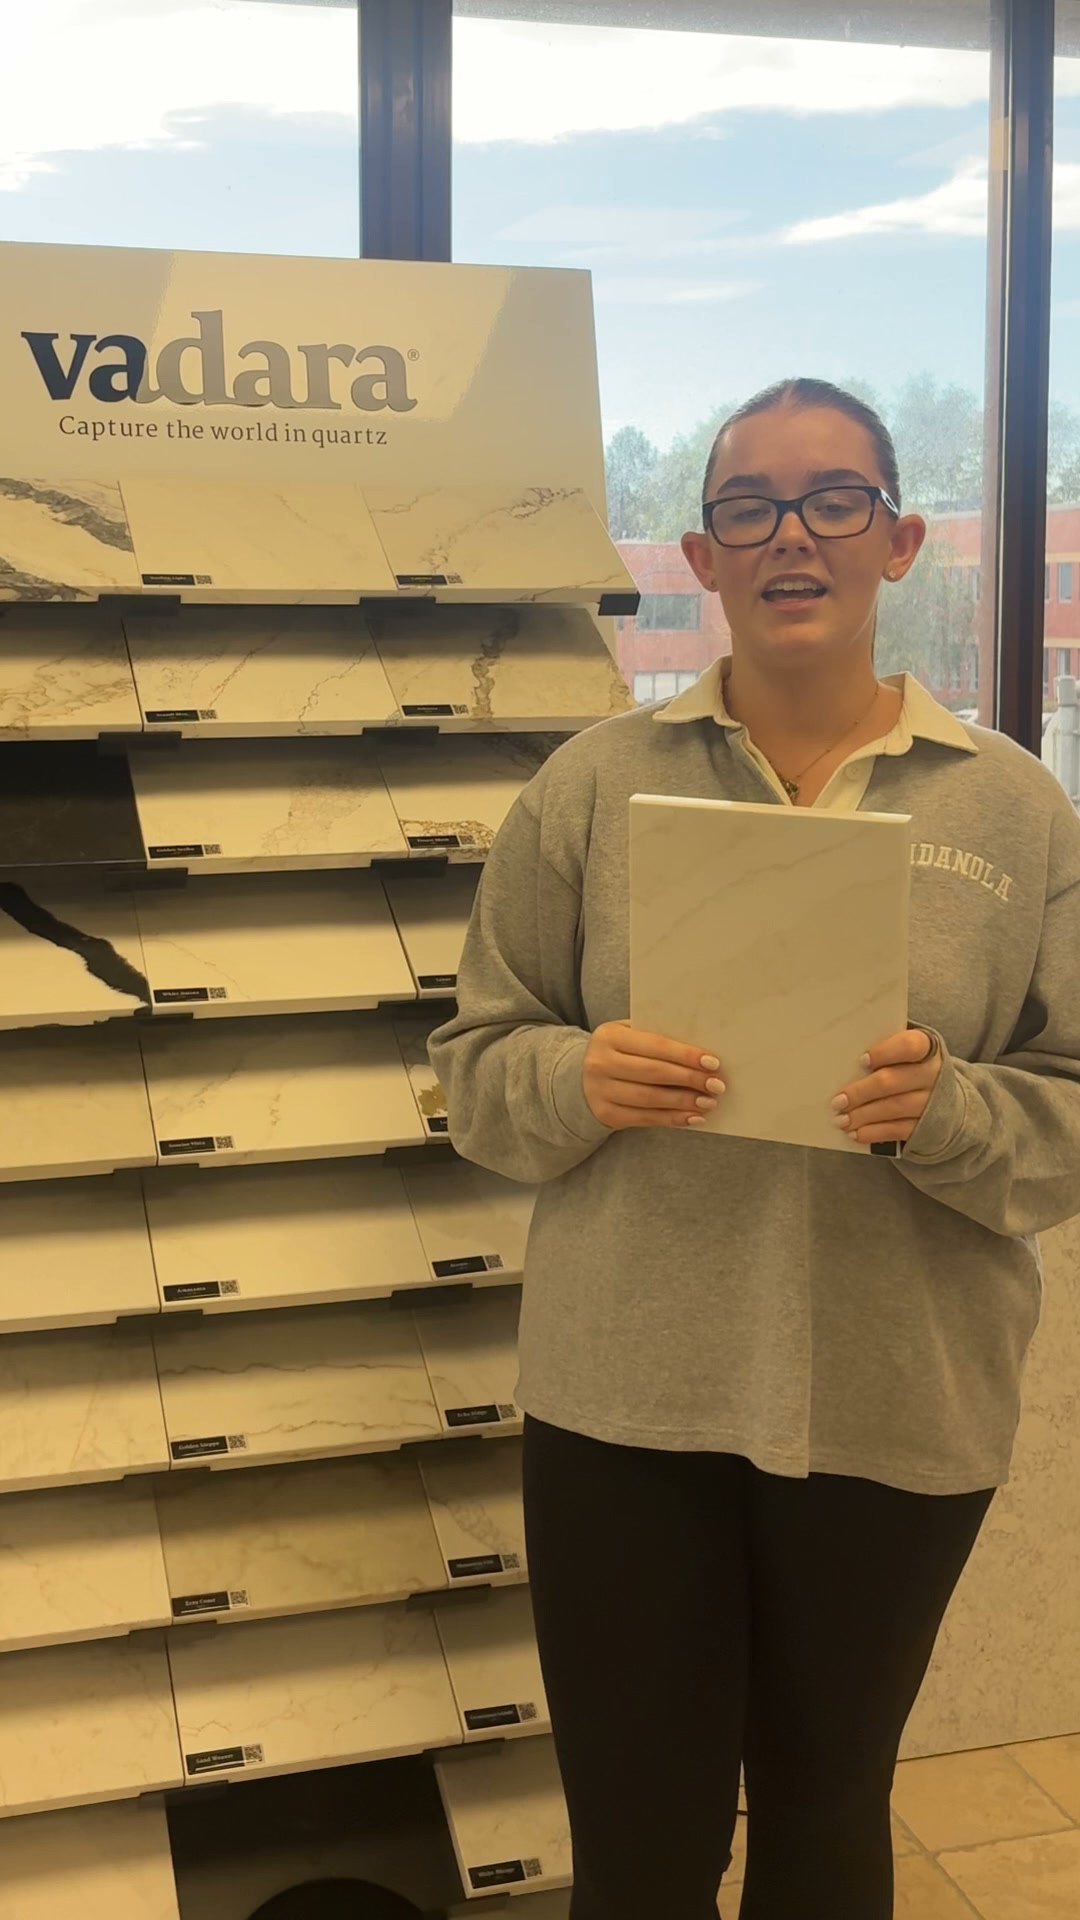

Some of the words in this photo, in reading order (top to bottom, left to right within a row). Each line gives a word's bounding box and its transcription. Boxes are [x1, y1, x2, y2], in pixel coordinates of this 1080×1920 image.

[59, 416, 158, 441] Capture
[166, 420, 204, 439] the
[210, 422, 278, 442] world
[285, 424, 306, 443] in
[312, 426, 387, 448] quartz
